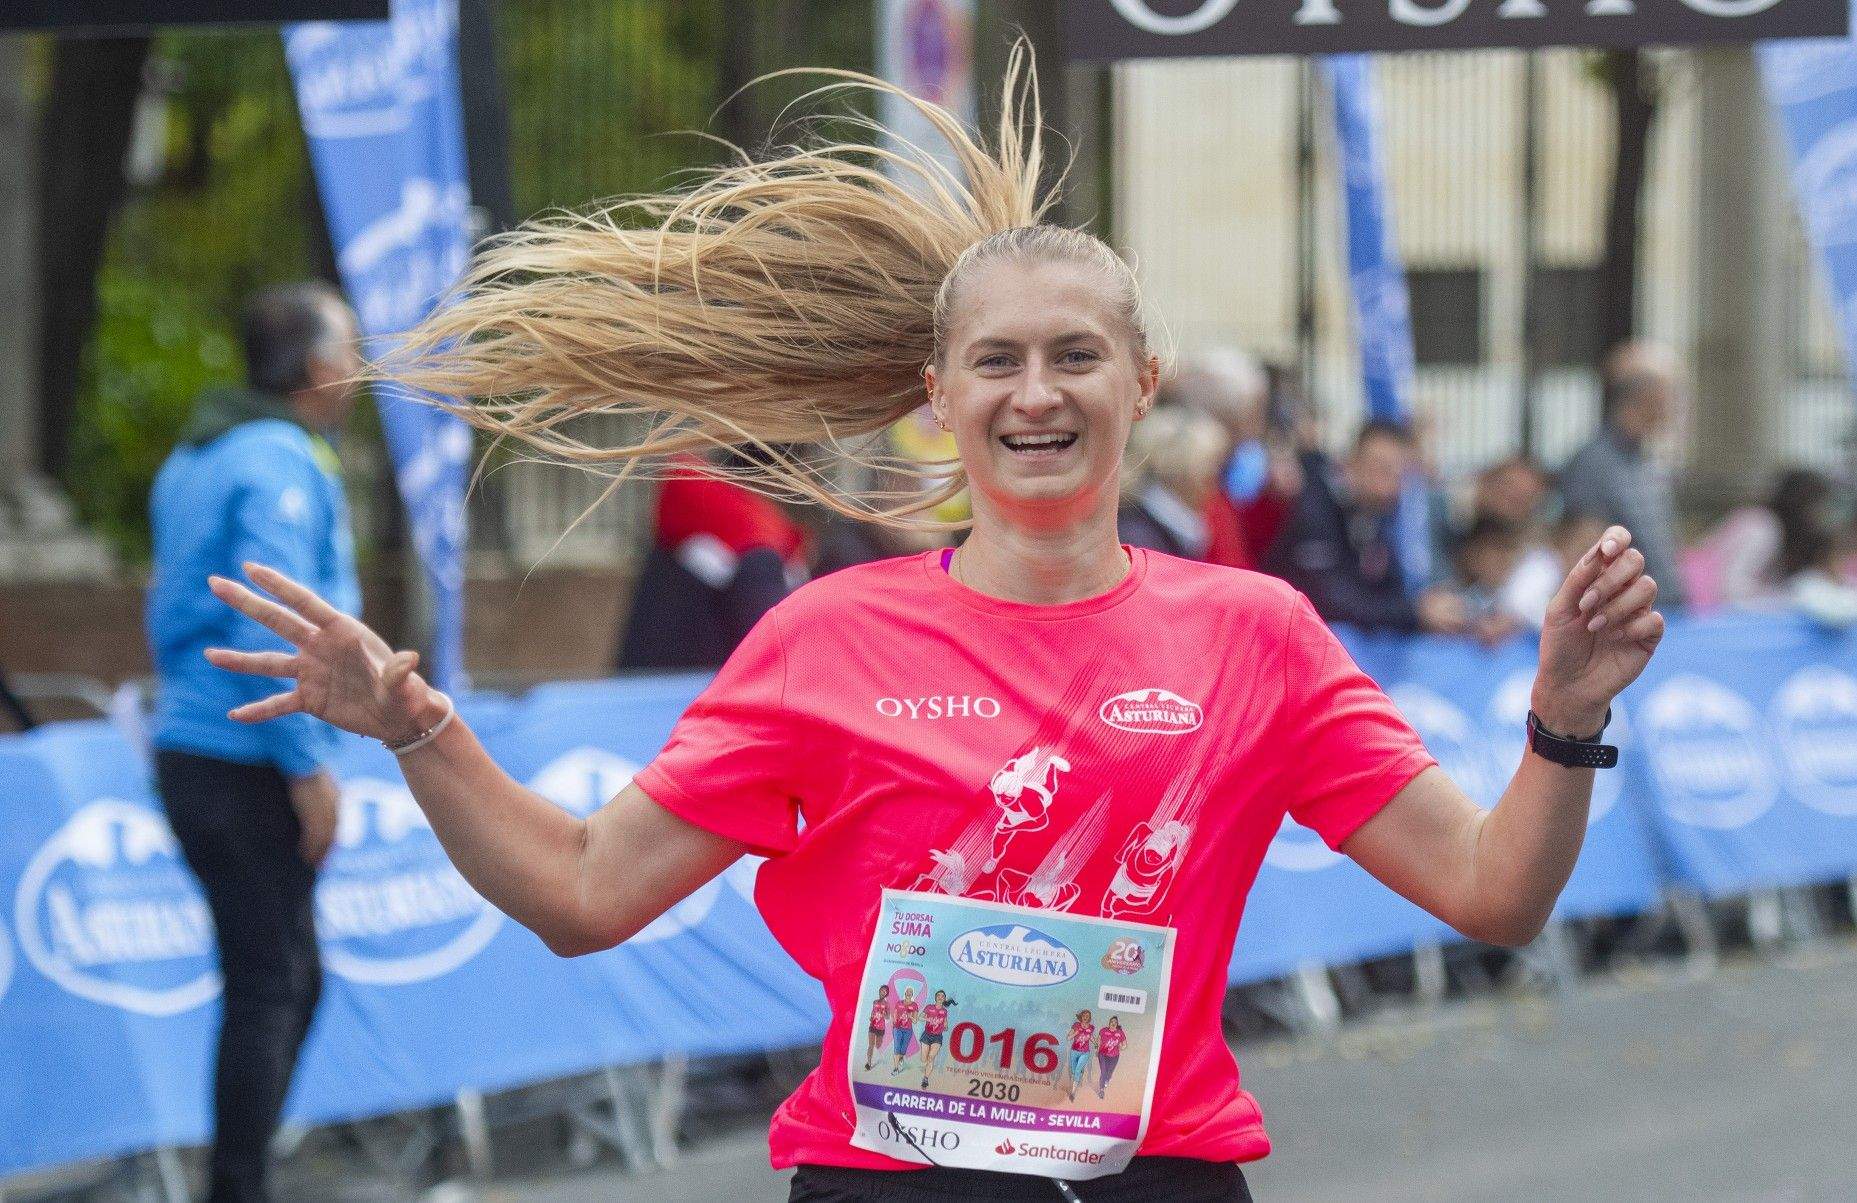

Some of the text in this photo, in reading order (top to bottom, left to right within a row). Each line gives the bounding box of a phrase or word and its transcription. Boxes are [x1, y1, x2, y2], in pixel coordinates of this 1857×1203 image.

[876, 695, 1001, 720] OYSHO
[1109, 703, 1197, 725] ASTURIANA
[894, 911, 935, 923] TU DORSAL
[891, 921, 931, 938] SUMA
[957, 940, 1068, 977] ASTURIANA
[949, 1021, 1060, 1075] 016
[967, 1078, 1020, 1102] 2030
[883, 1091, 1101, 1129] CARRERA DE LA MUJER SEVILLA
[1018, 1143, 1106, 1165] Santander
